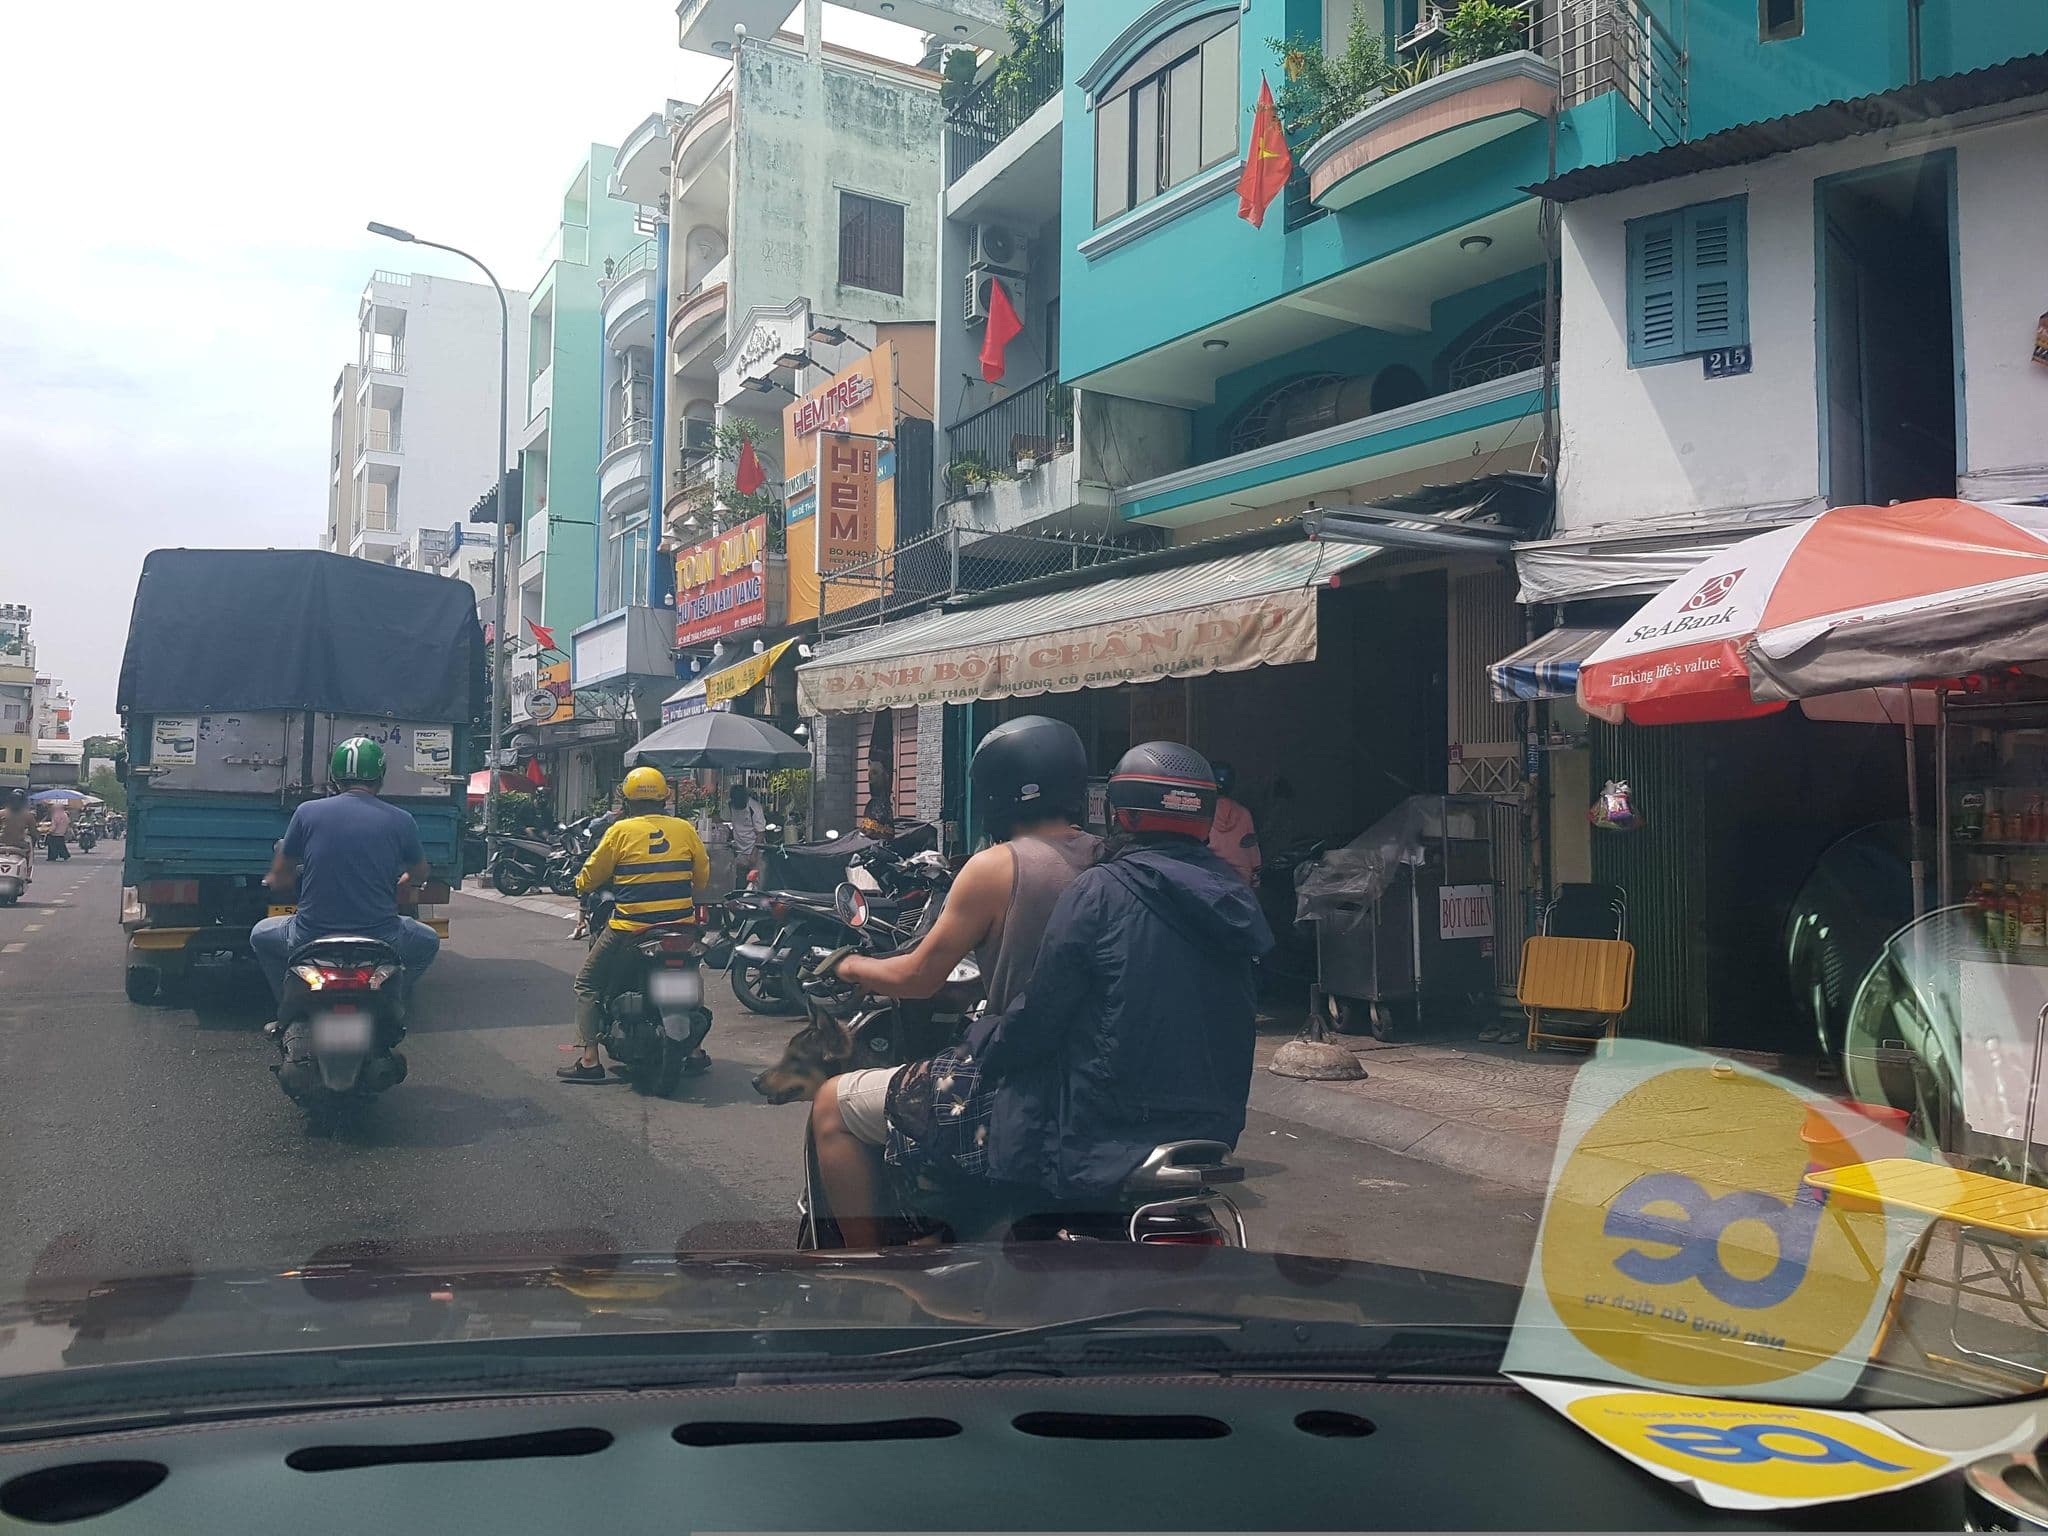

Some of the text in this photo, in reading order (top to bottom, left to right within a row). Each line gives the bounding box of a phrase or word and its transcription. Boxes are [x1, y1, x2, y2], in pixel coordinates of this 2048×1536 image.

[1710, 349, 1746, 369] 215
[826, 372, 862, 416] TRE
[1625, 606, 1739, 643] SeABank
[1084, 667, 1135, 683] GIANG
[1611, 670, 1654, 687] Linking
[1655, 662, 1681, 679] life's
